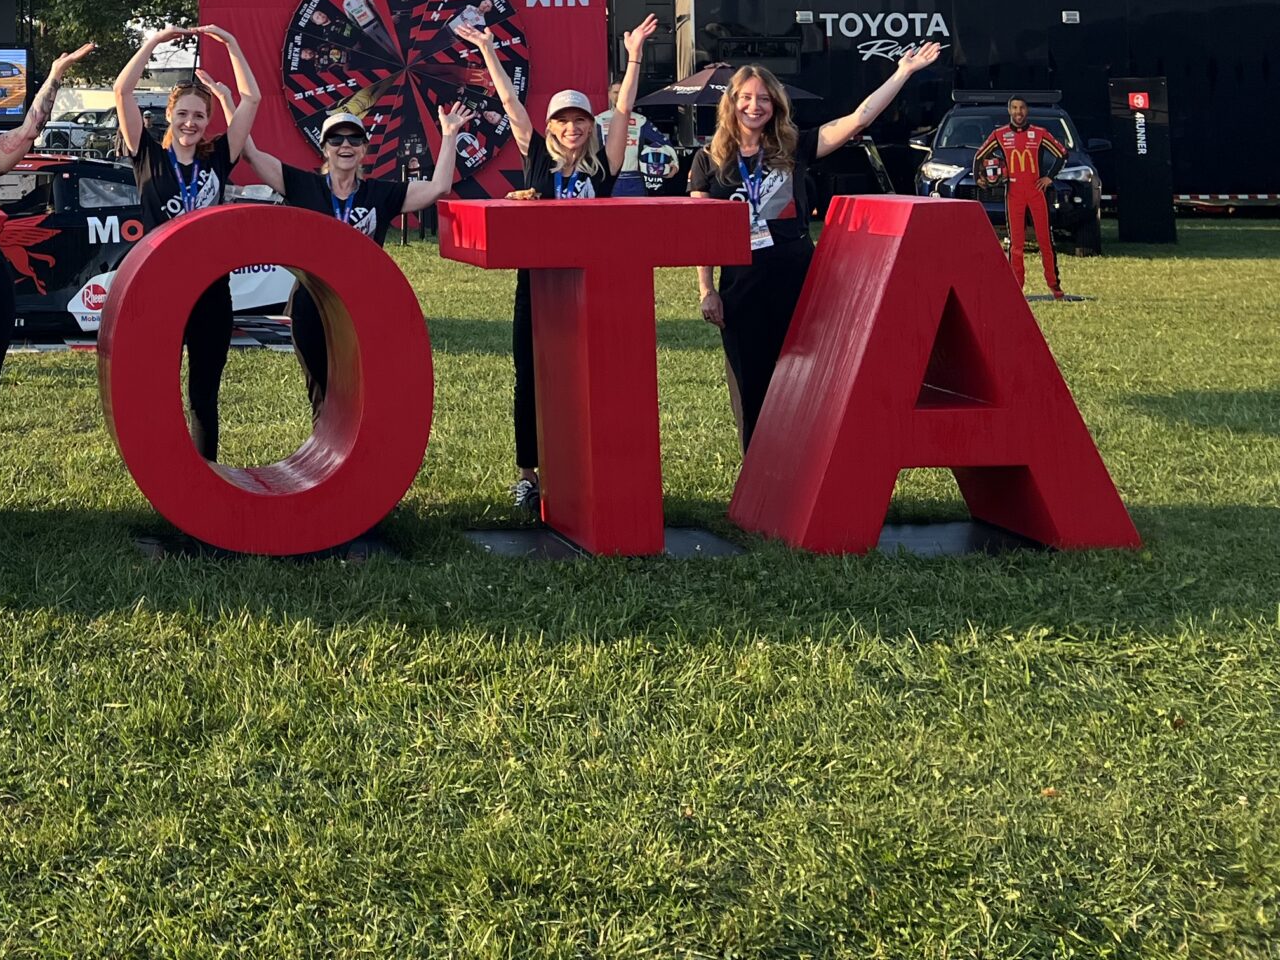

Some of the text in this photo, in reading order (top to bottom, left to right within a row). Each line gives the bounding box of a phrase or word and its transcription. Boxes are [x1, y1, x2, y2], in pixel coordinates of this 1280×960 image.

[819, 13, 950, 37] TOYOTA
[459, 37, 521, 59] WINER
[1134, 111, 1147, 155] 4RUNNER
